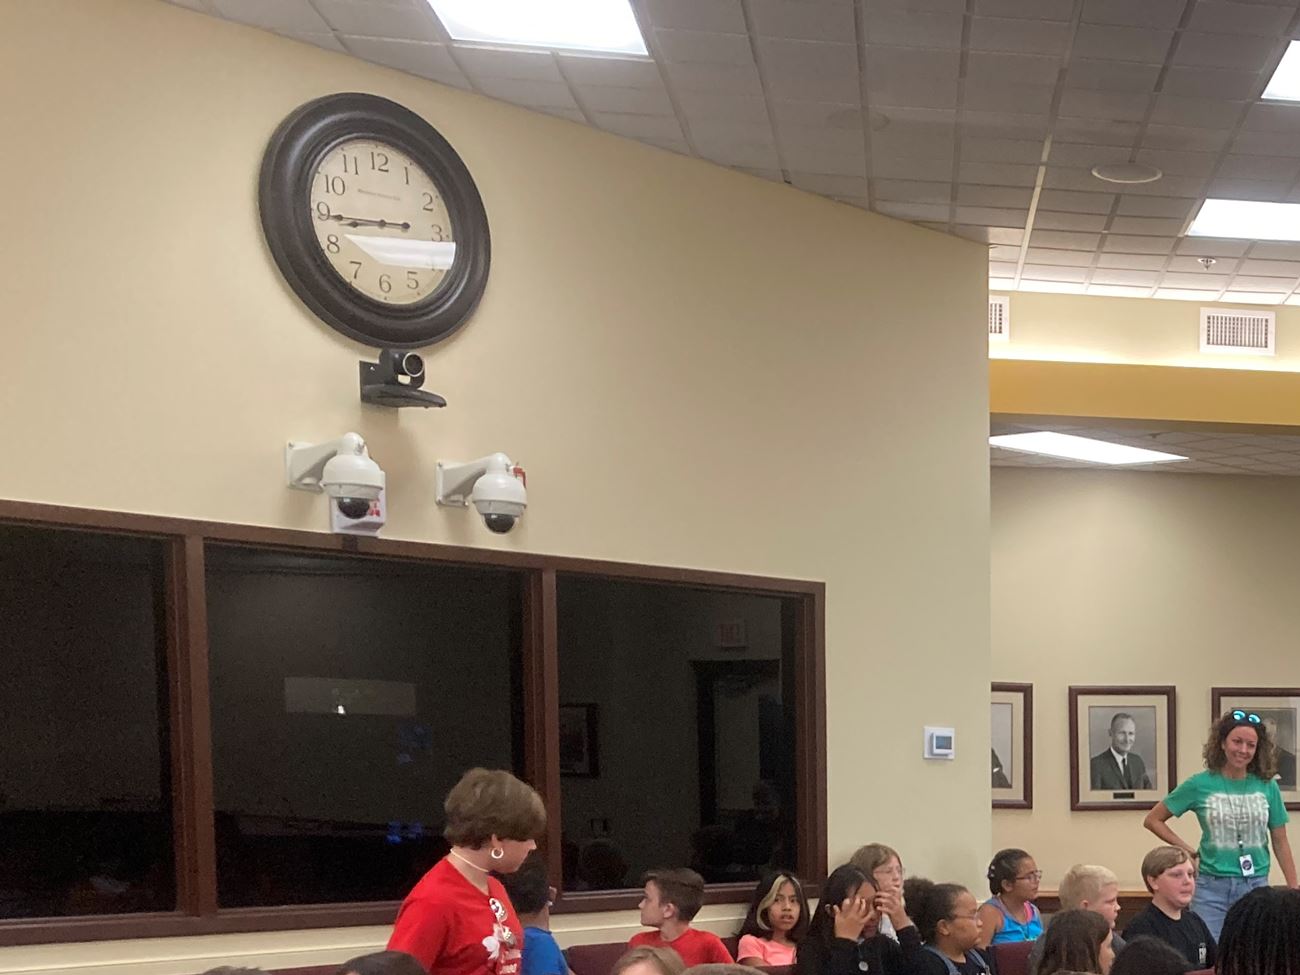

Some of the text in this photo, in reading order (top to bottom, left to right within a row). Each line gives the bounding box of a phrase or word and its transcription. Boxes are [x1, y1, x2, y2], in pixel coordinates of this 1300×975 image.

[343, 154, 359, 176] 11
[370, 151, 389, 173] 12
[325, 174, 346, 196] 10
[404, 166, 410, 185] 1
[316, 201, 331, 221] 9
[422, 192, 434, 212] 2
[431, 224, 443, 242] 3
[326, 234, 341, 254] 8
[349, 261, 362, 279] 7
[378, 274, 392, 293] 6
[407, 271, 419, 290] 5
